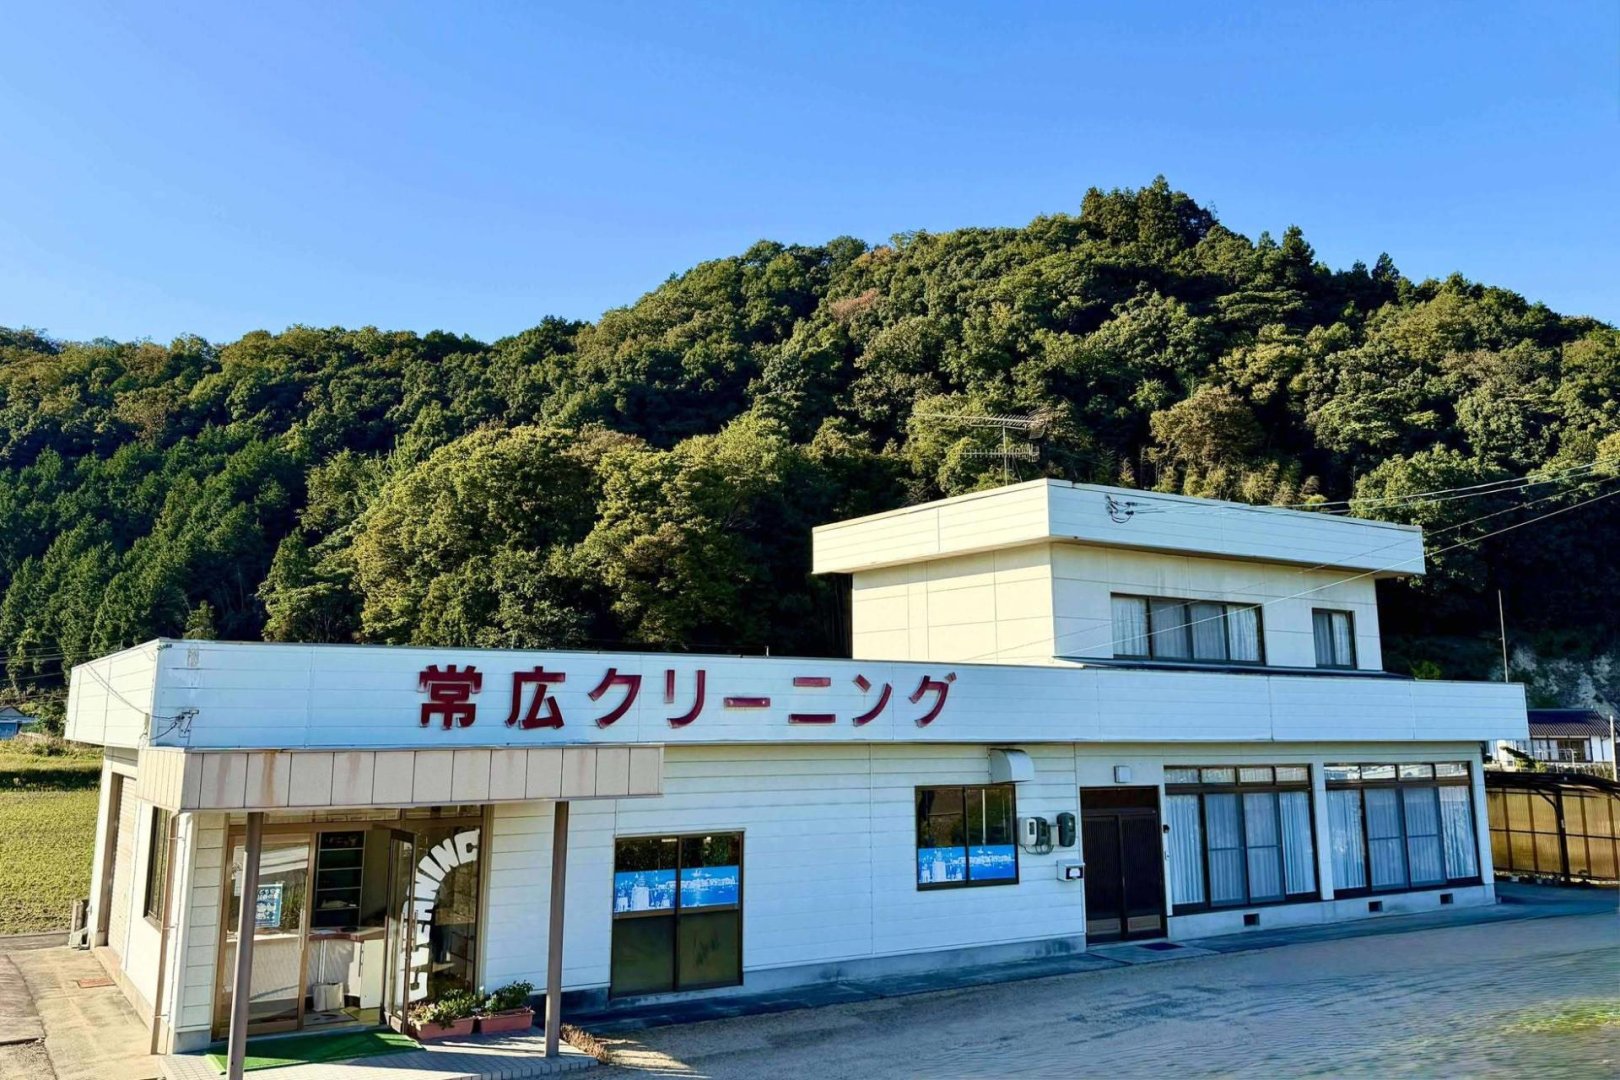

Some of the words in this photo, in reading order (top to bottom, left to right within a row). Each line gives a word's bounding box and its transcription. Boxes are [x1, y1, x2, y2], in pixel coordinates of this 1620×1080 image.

[417, 664, 957, 731] 常広クリーニング
